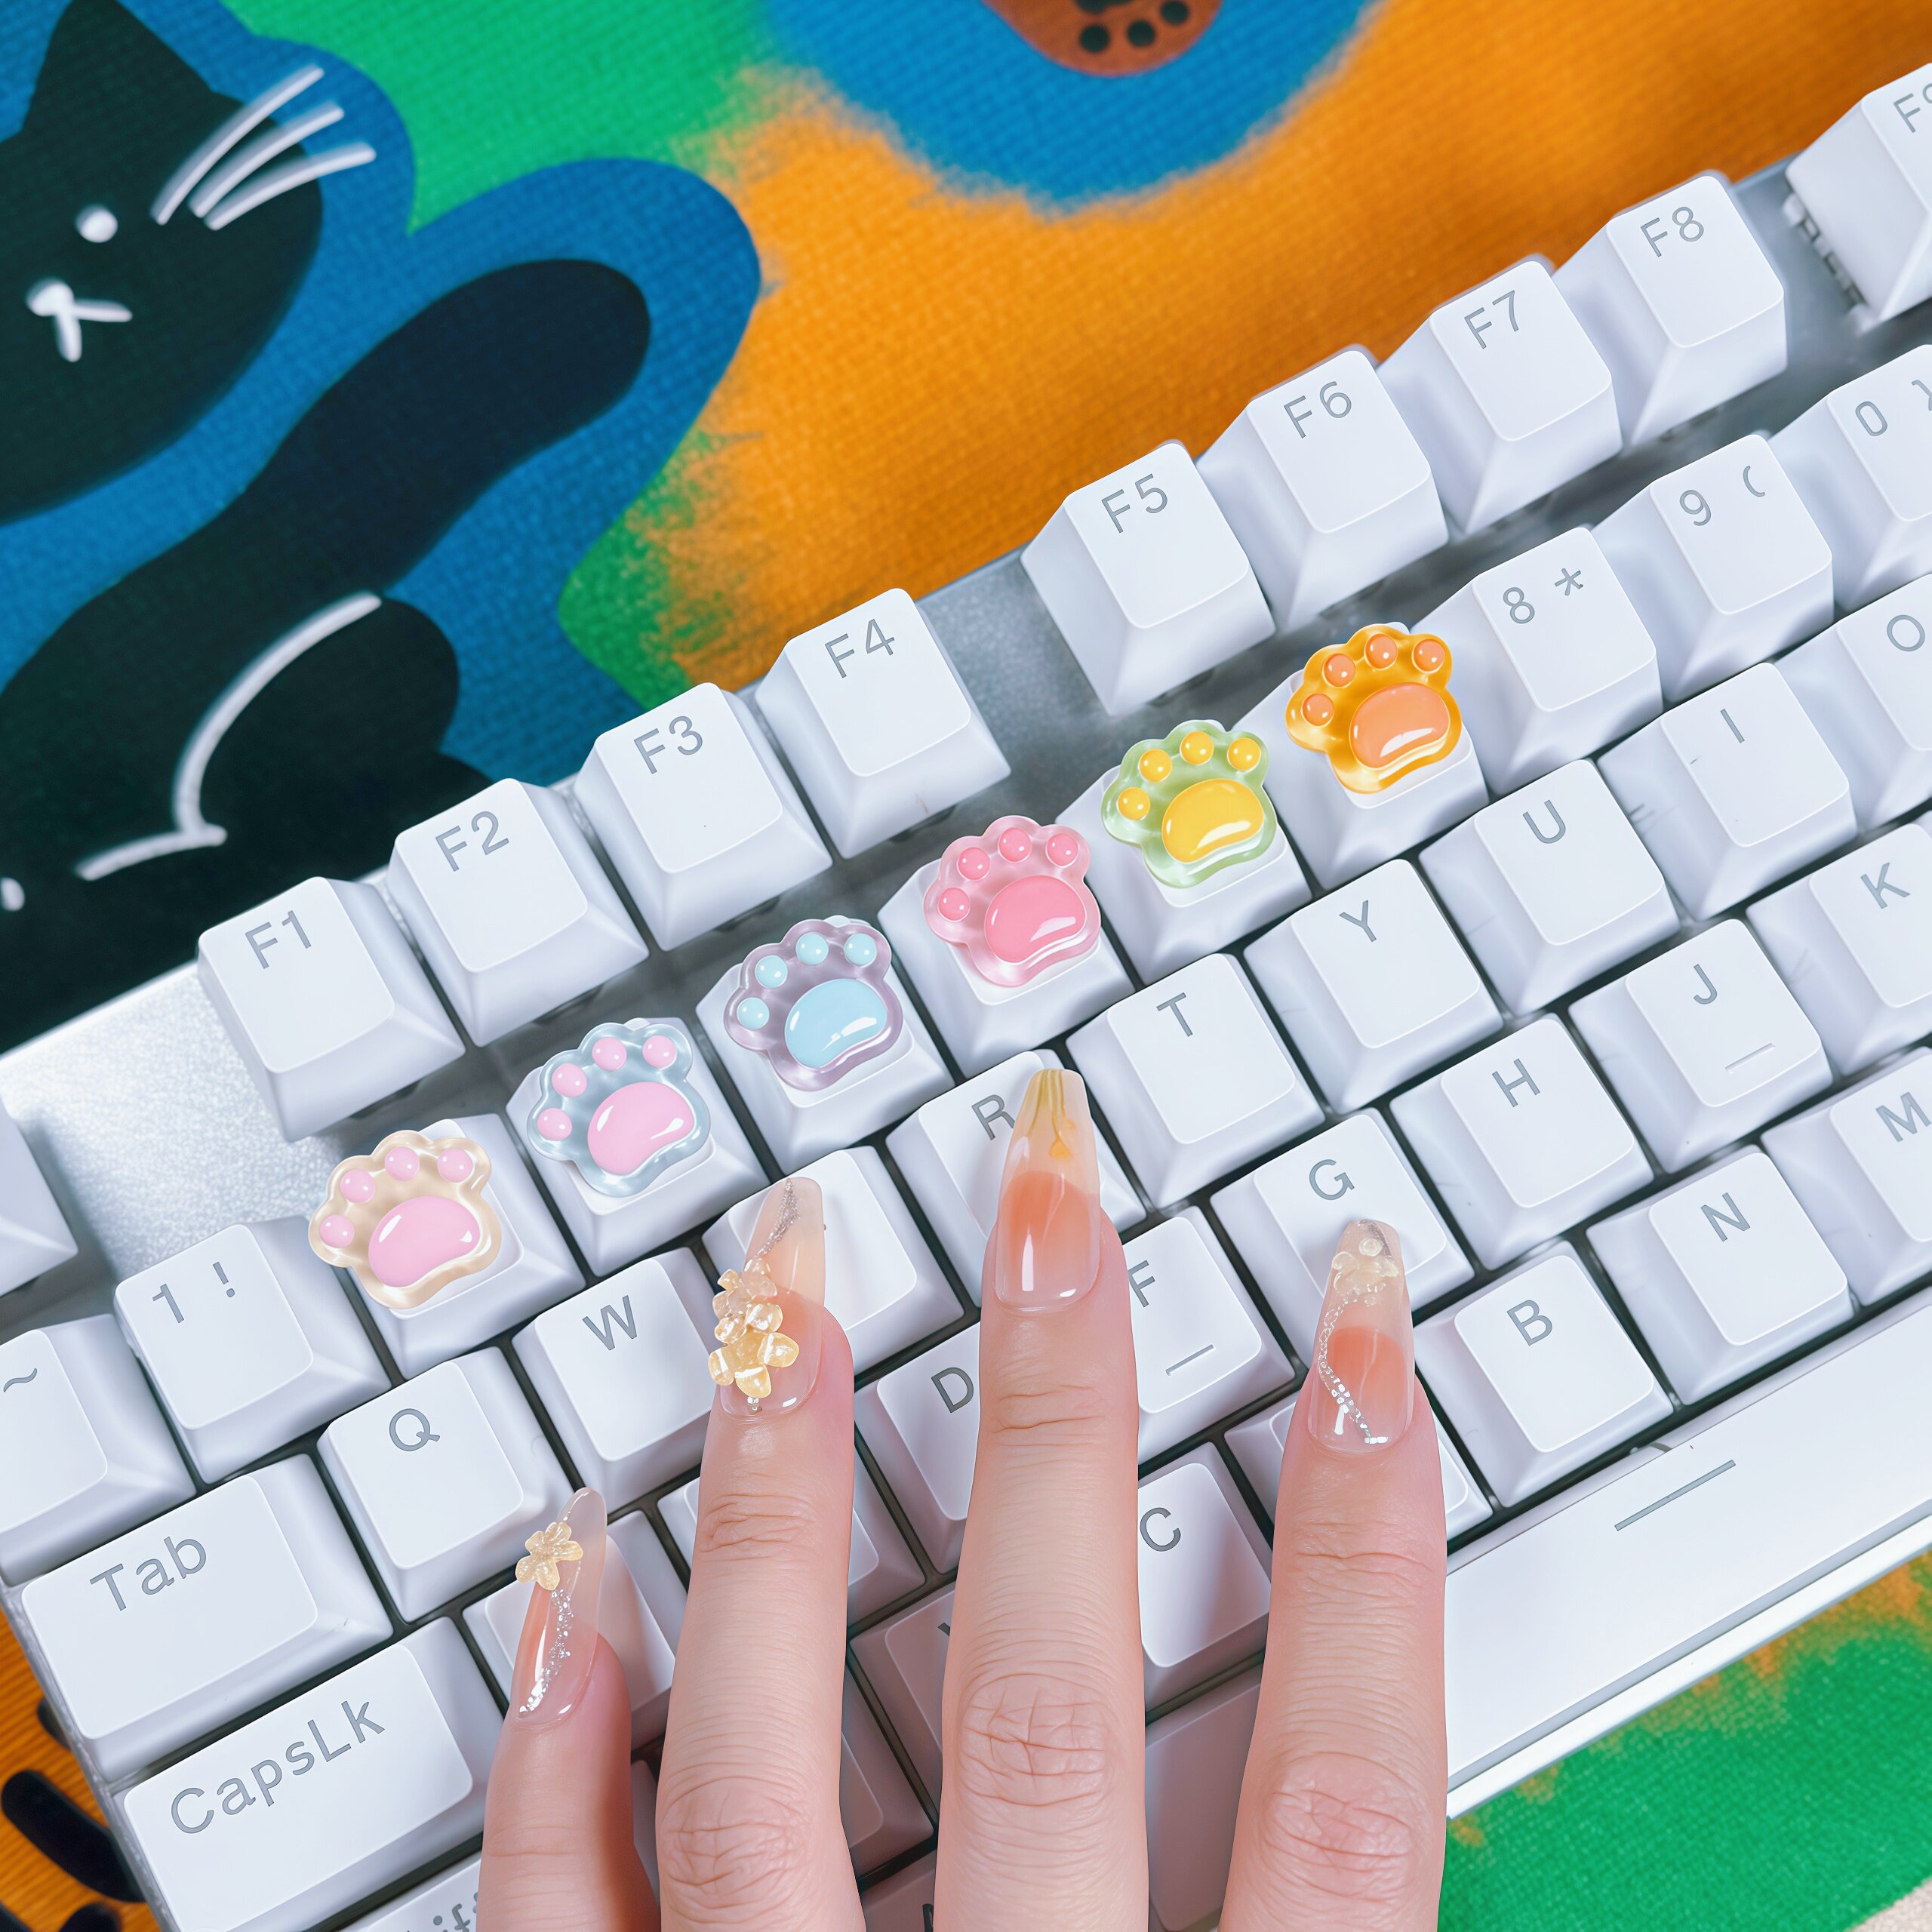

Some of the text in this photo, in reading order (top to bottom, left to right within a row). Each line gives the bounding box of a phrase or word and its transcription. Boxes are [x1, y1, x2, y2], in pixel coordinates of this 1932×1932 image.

[1640, 206, 1705, 258] F8
[1463, 290, 1519, 349] F7
[1283, 380, 1352, 439] F6
[1854, 401, 1888, 437] 0
[1101, 473, 1168, 534] F5
[1679, 465, 1766, 527] 9 (
[1503, 586, 1536, 625] 8
[824, 618, 895, 678] F4
[1886, 614, 1926, 652] O
[633, 715, 703, 774] F3
[1720, 708, 1746, 743] I
[435, 811, 509, 872] F2
[1522, 799, 1567, 844] U
[1860, 862, 1911, 909] K
[245, 909, 312, 970] F1
[1338, 900, 1377, 943] Y
[1693, 963, 1718, 1005] J
[1155, 992, 1194, 1038] T
[1491, 1058, 1541, 1108] H
[971, 1094, 1016, 1141] R
[1875, 1091, 1932, 1143] M
[1309, 1158, 1355, 1201] G
[1700, 1192, 1751, 1242] N
[152, 1261, 235, 1324] 1 !
[1128, 1260, 1155, 1308] F
[582, 1294, 638, 1351] W
[1506, 1300, 1553, 1347] B
[931, 1367, 974, 1414] D
[389, 1407, 441, 1452] Q
[1140, 1506, 1182, 1552] C
[89, 1536, 207, 1611] Tab
[171, 1700, 386, 1834] CapsLk
